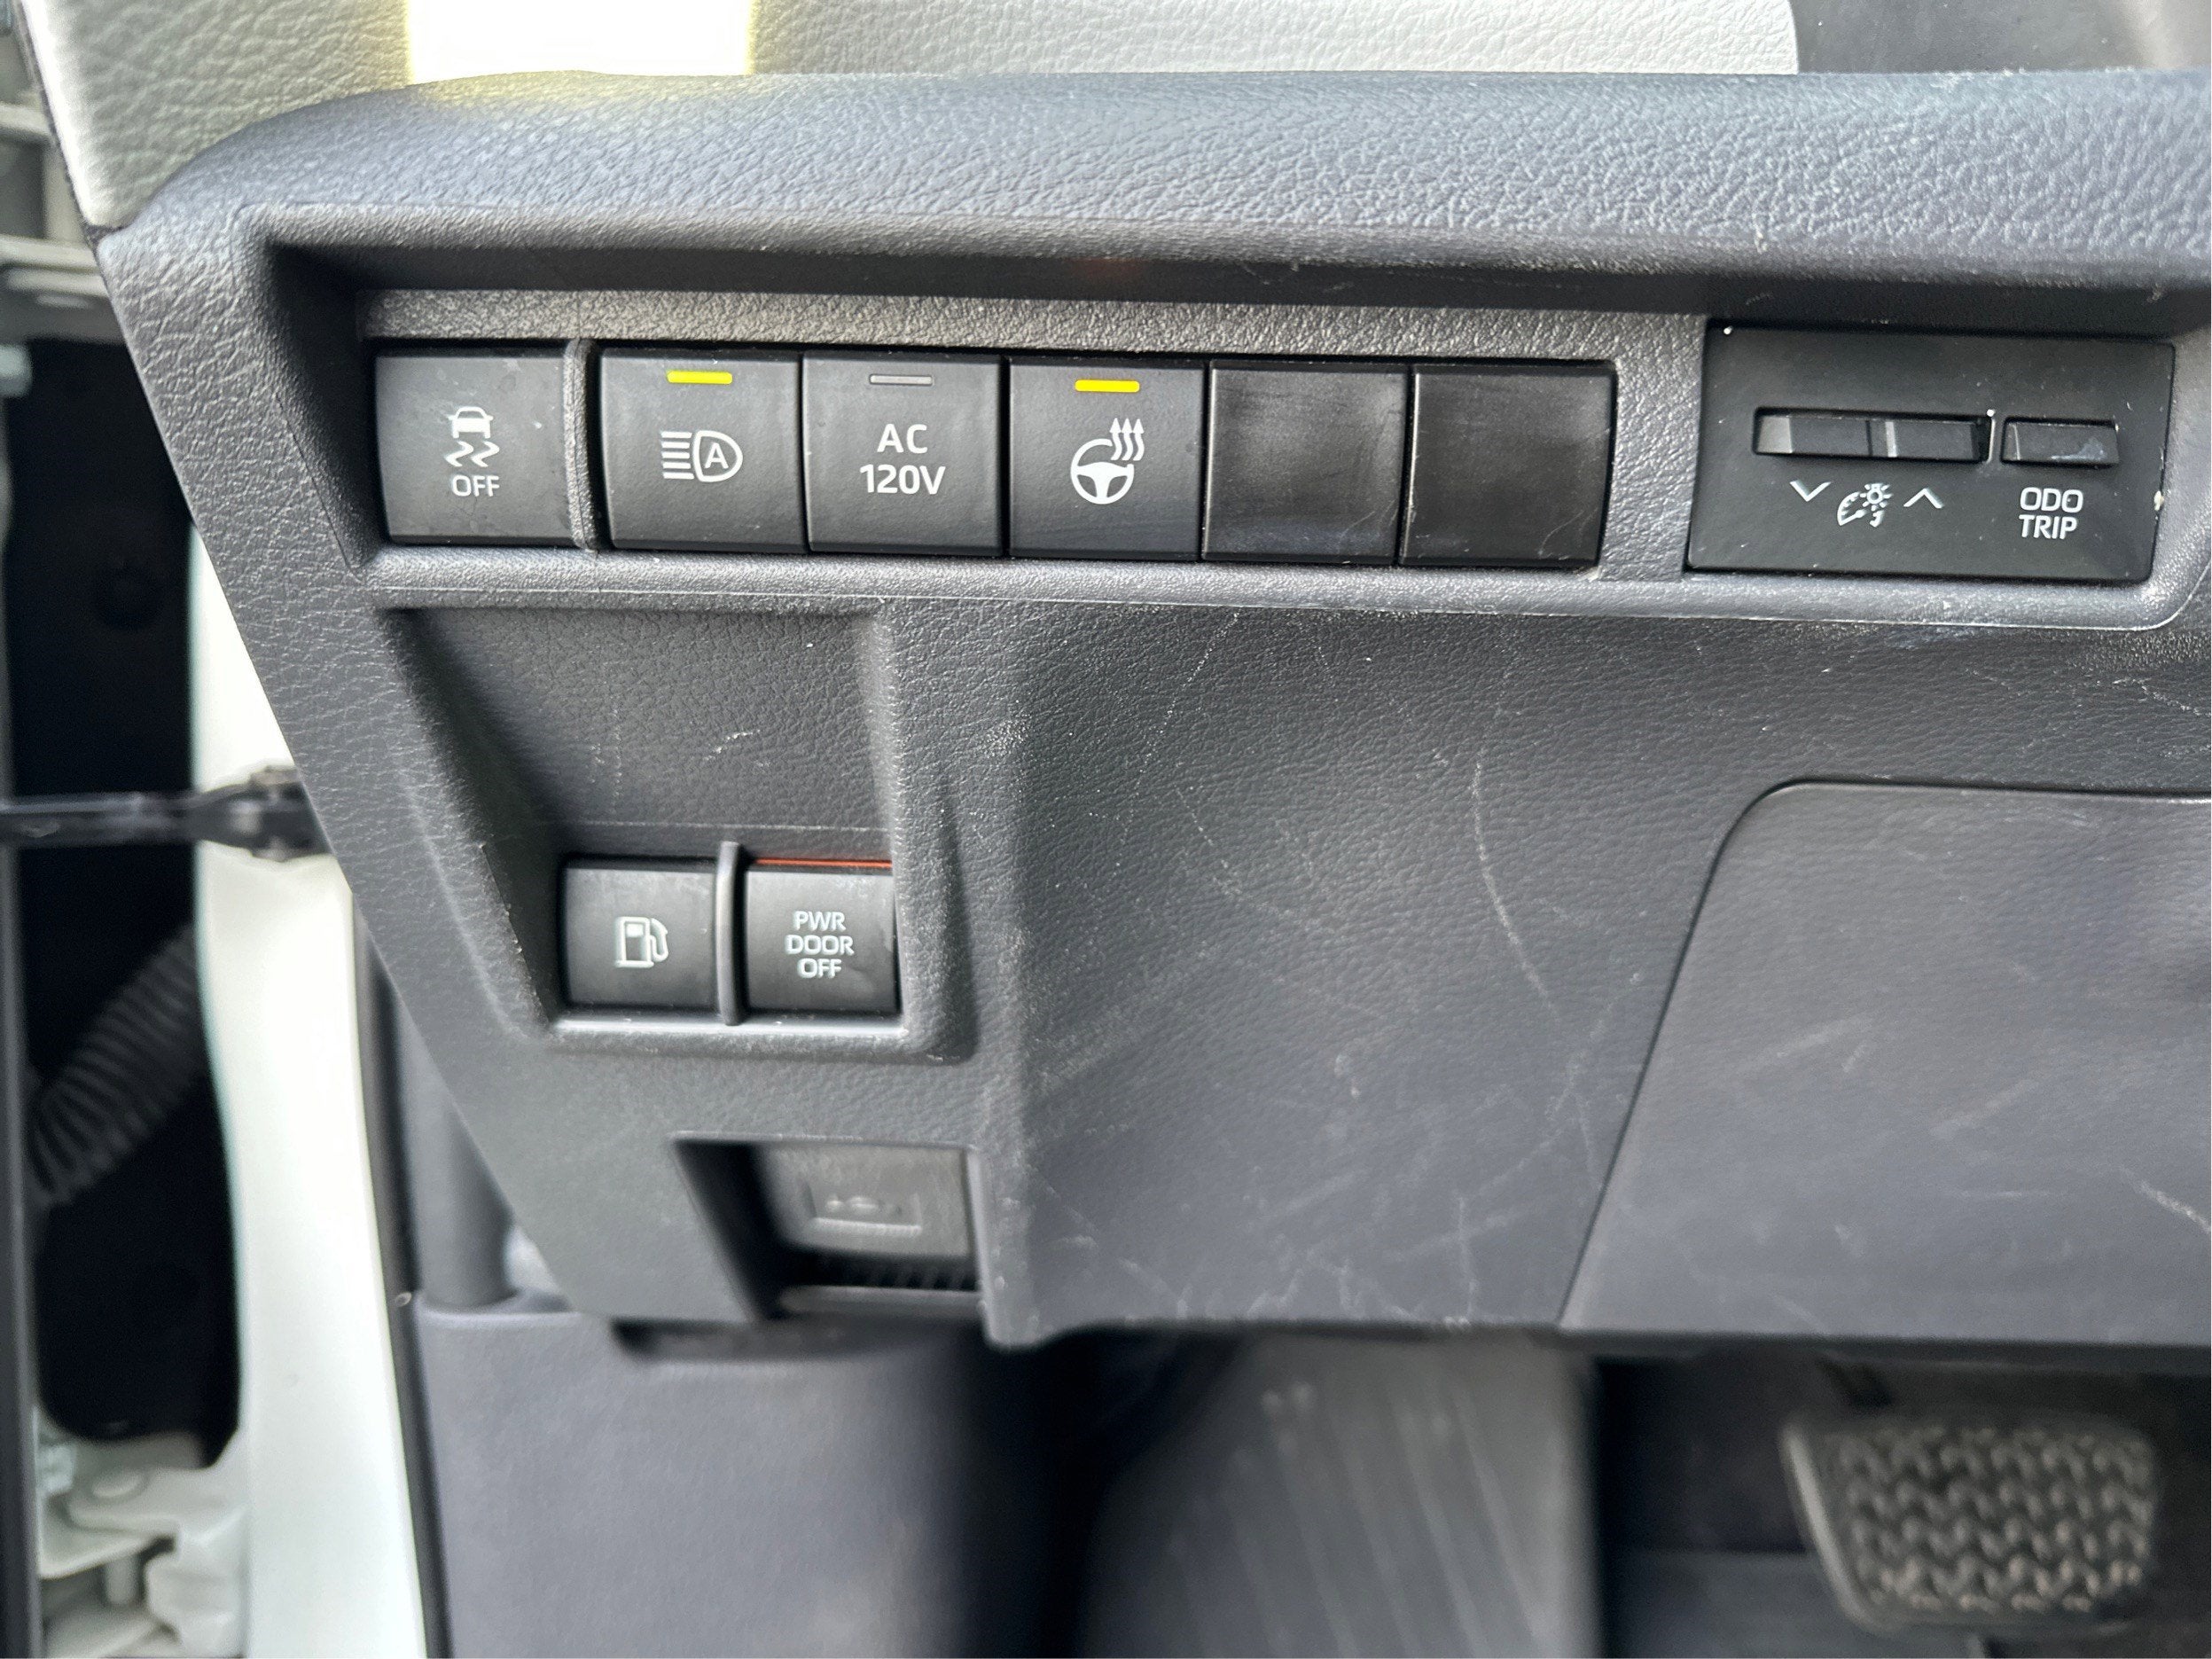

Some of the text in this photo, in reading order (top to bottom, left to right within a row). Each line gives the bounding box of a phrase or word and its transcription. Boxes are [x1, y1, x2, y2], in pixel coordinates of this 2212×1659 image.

[877, 423, 928, 454] AC
[704, 442, 729, 469] A
[450, 473, 501, 497] OFF
[859, 464, 946, 495] 120V
[2018, 487, 2083, 513] ODO
[2018, 514, 2078, 540] TRIP
[793, 911, 848, 931] PWR
[786, 934, 855, 955] DOOR
[798, 958, 843, 978] OFF
